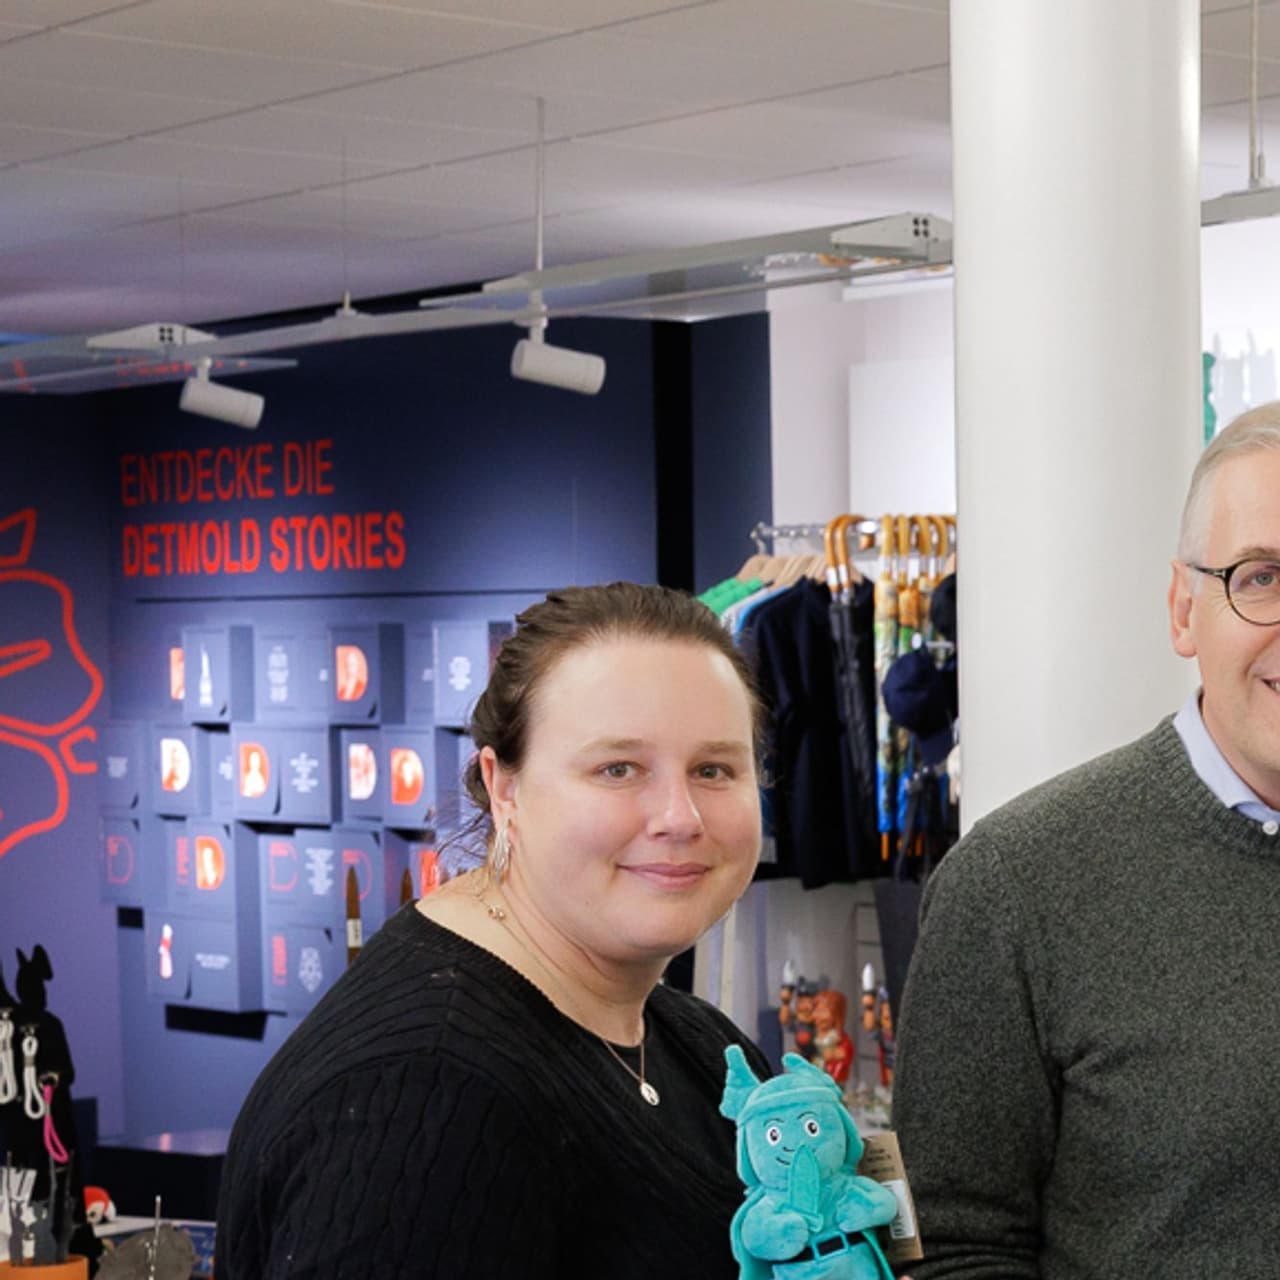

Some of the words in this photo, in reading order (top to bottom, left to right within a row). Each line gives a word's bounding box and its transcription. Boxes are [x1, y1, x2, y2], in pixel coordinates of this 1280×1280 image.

[120, 443, 275, 507] ENTDECKE
[283, 439, 335, 496] DIE
[122, 517, 262, 576] DETMOLD
[269, 511, 407, 573] STORIES
